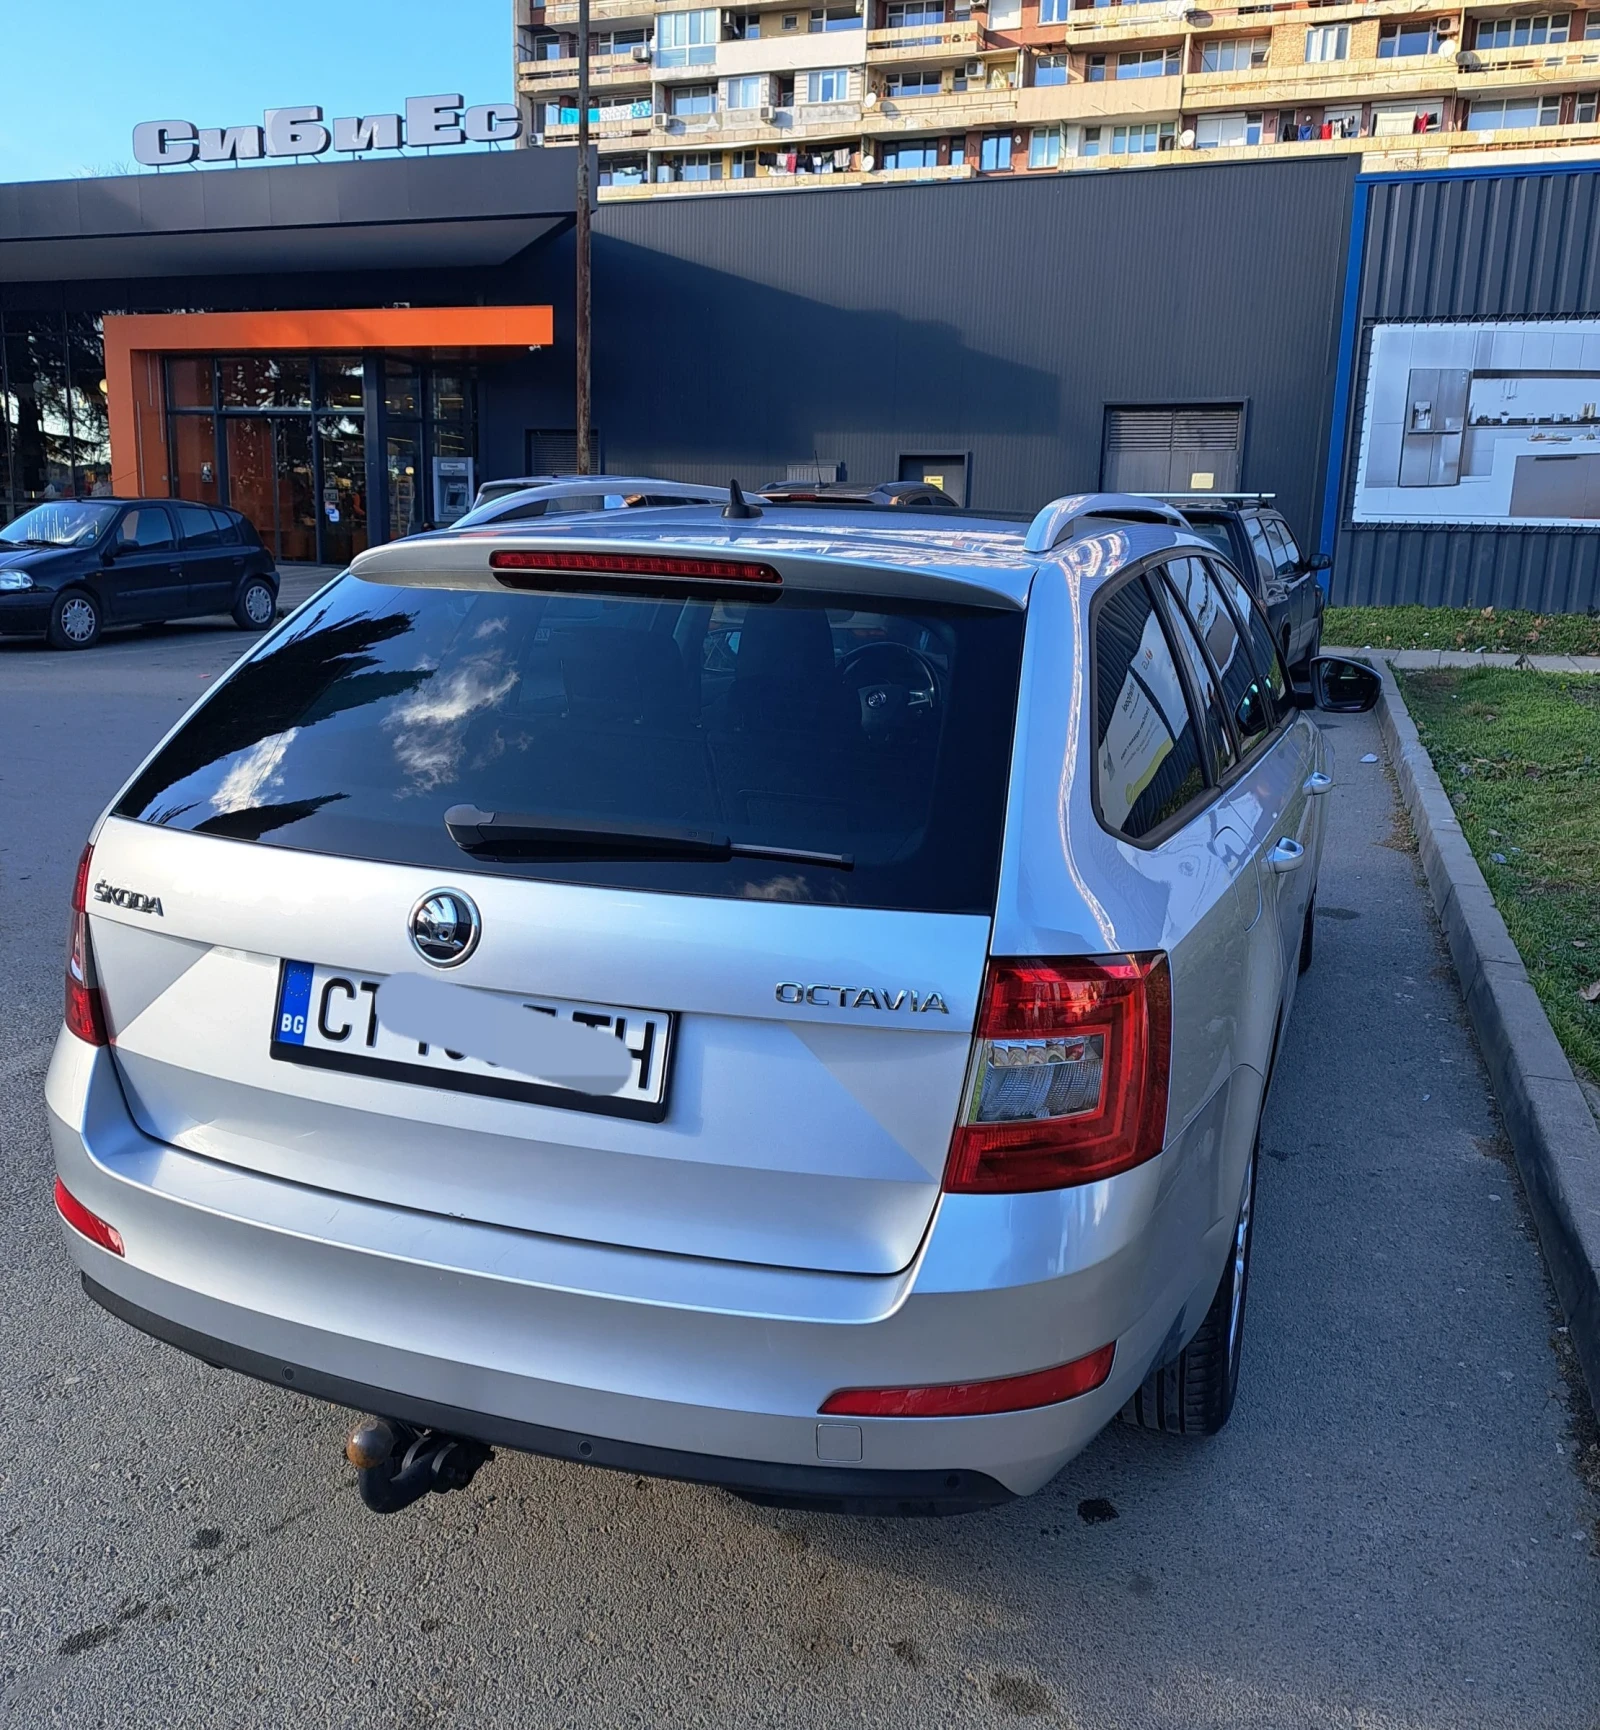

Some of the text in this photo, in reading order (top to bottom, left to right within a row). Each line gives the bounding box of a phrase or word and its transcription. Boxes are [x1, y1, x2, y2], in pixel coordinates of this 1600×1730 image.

[132, 93, 523, 166] СиБиЕс
[93, 879, 164, 917] ŠKODA
[775, 981, 950, 1014] OCTAVIA
[281, 1012, 304, 1034] BG
